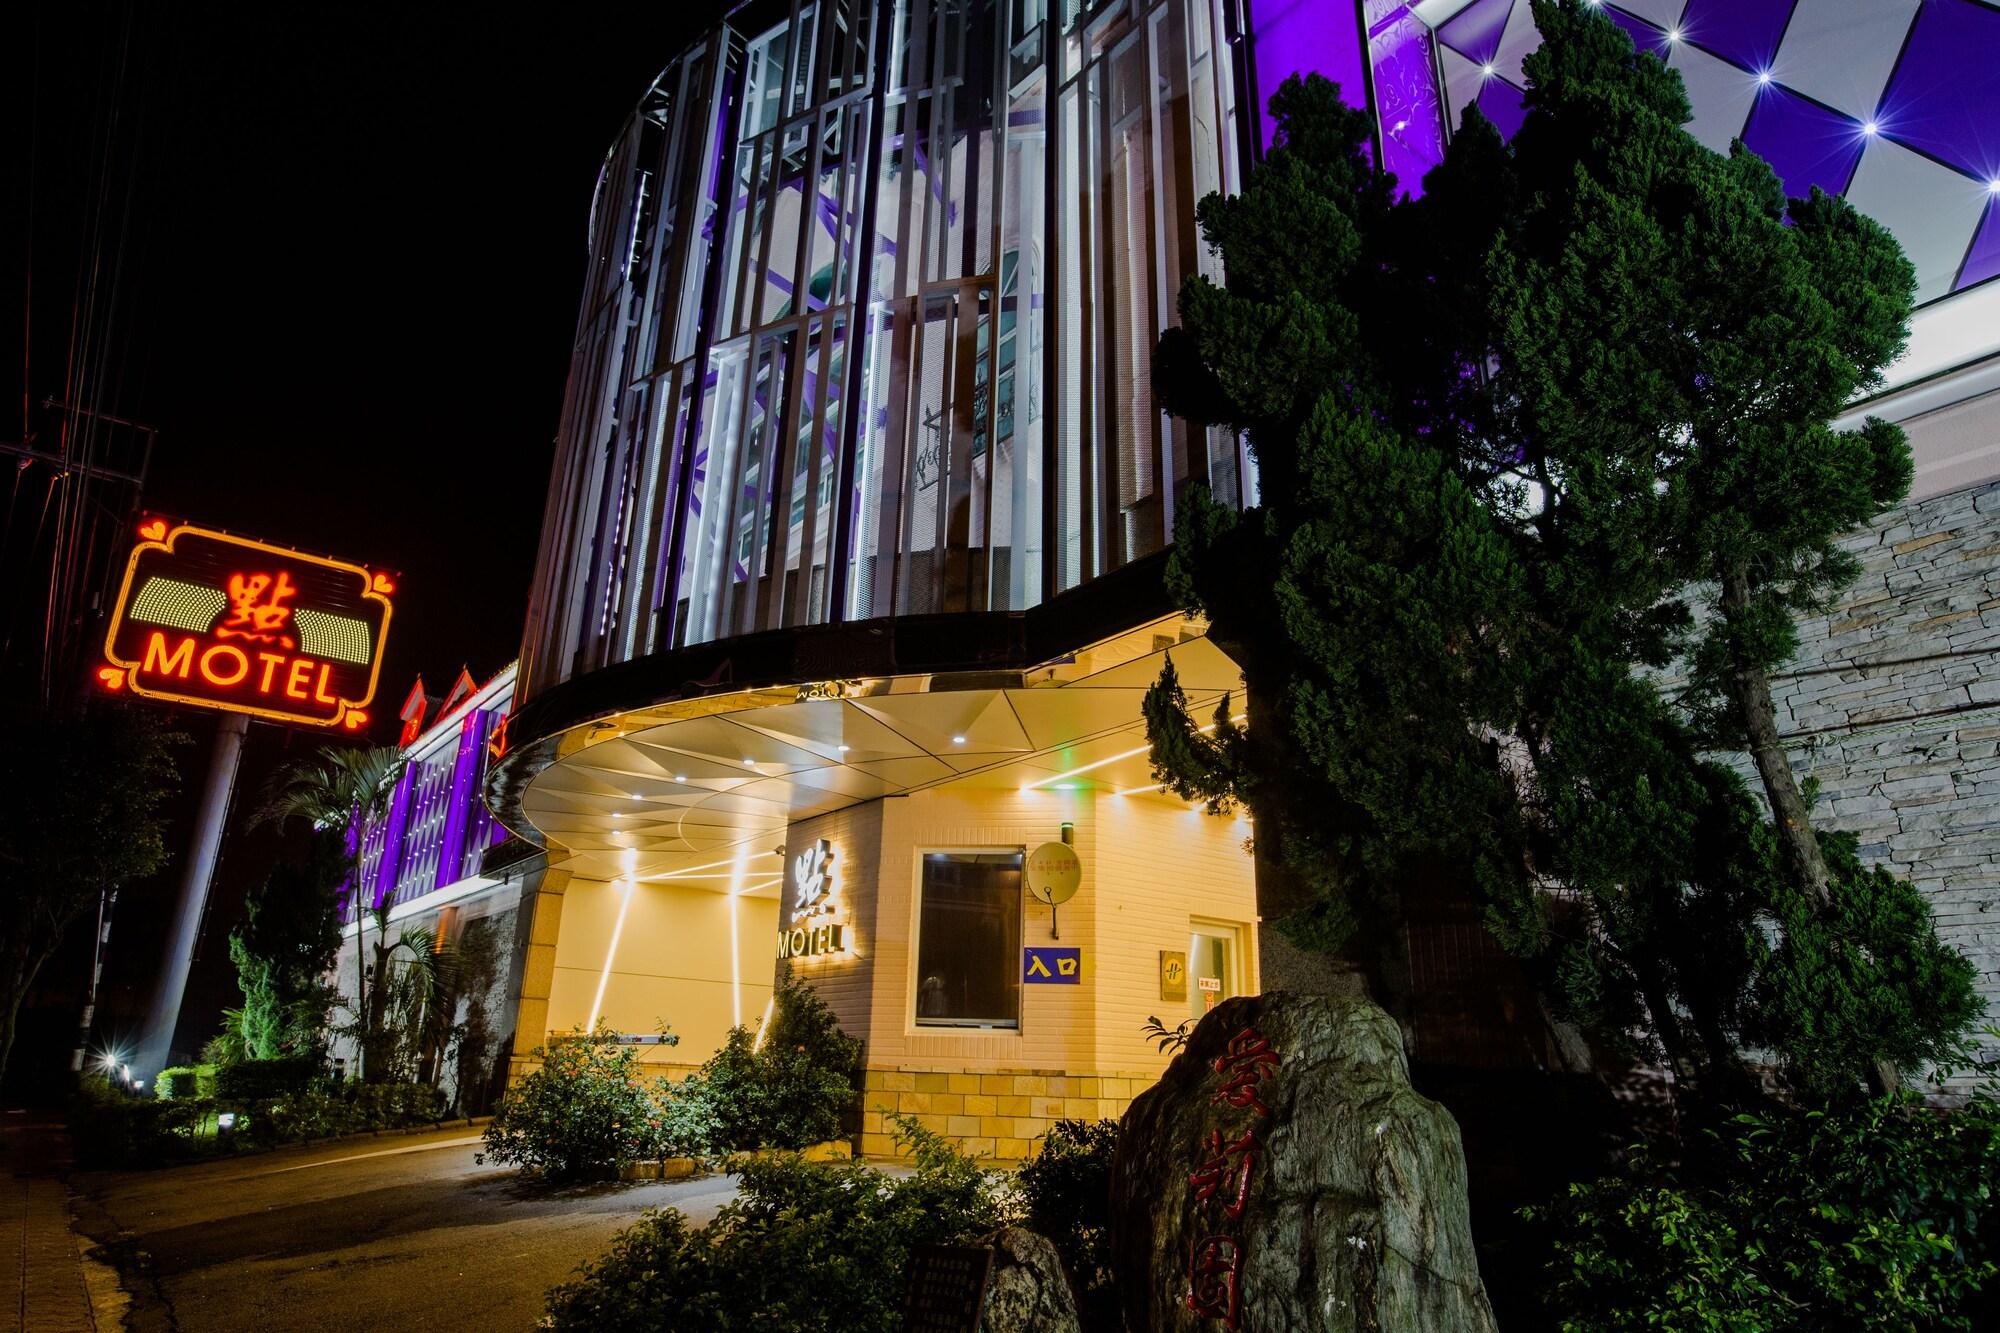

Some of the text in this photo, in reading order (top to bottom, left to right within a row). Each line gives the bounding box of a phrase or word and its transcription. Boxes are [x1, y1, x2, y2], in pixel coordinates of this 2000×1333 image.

[214, 570, 297, 649] 點
[142, 631, 338, 704] MOTEL
[791, 837, 833, 923] 點
[776, 923, 839, 959] MOTEL
[1027, 955, 1077, 978] 入口
